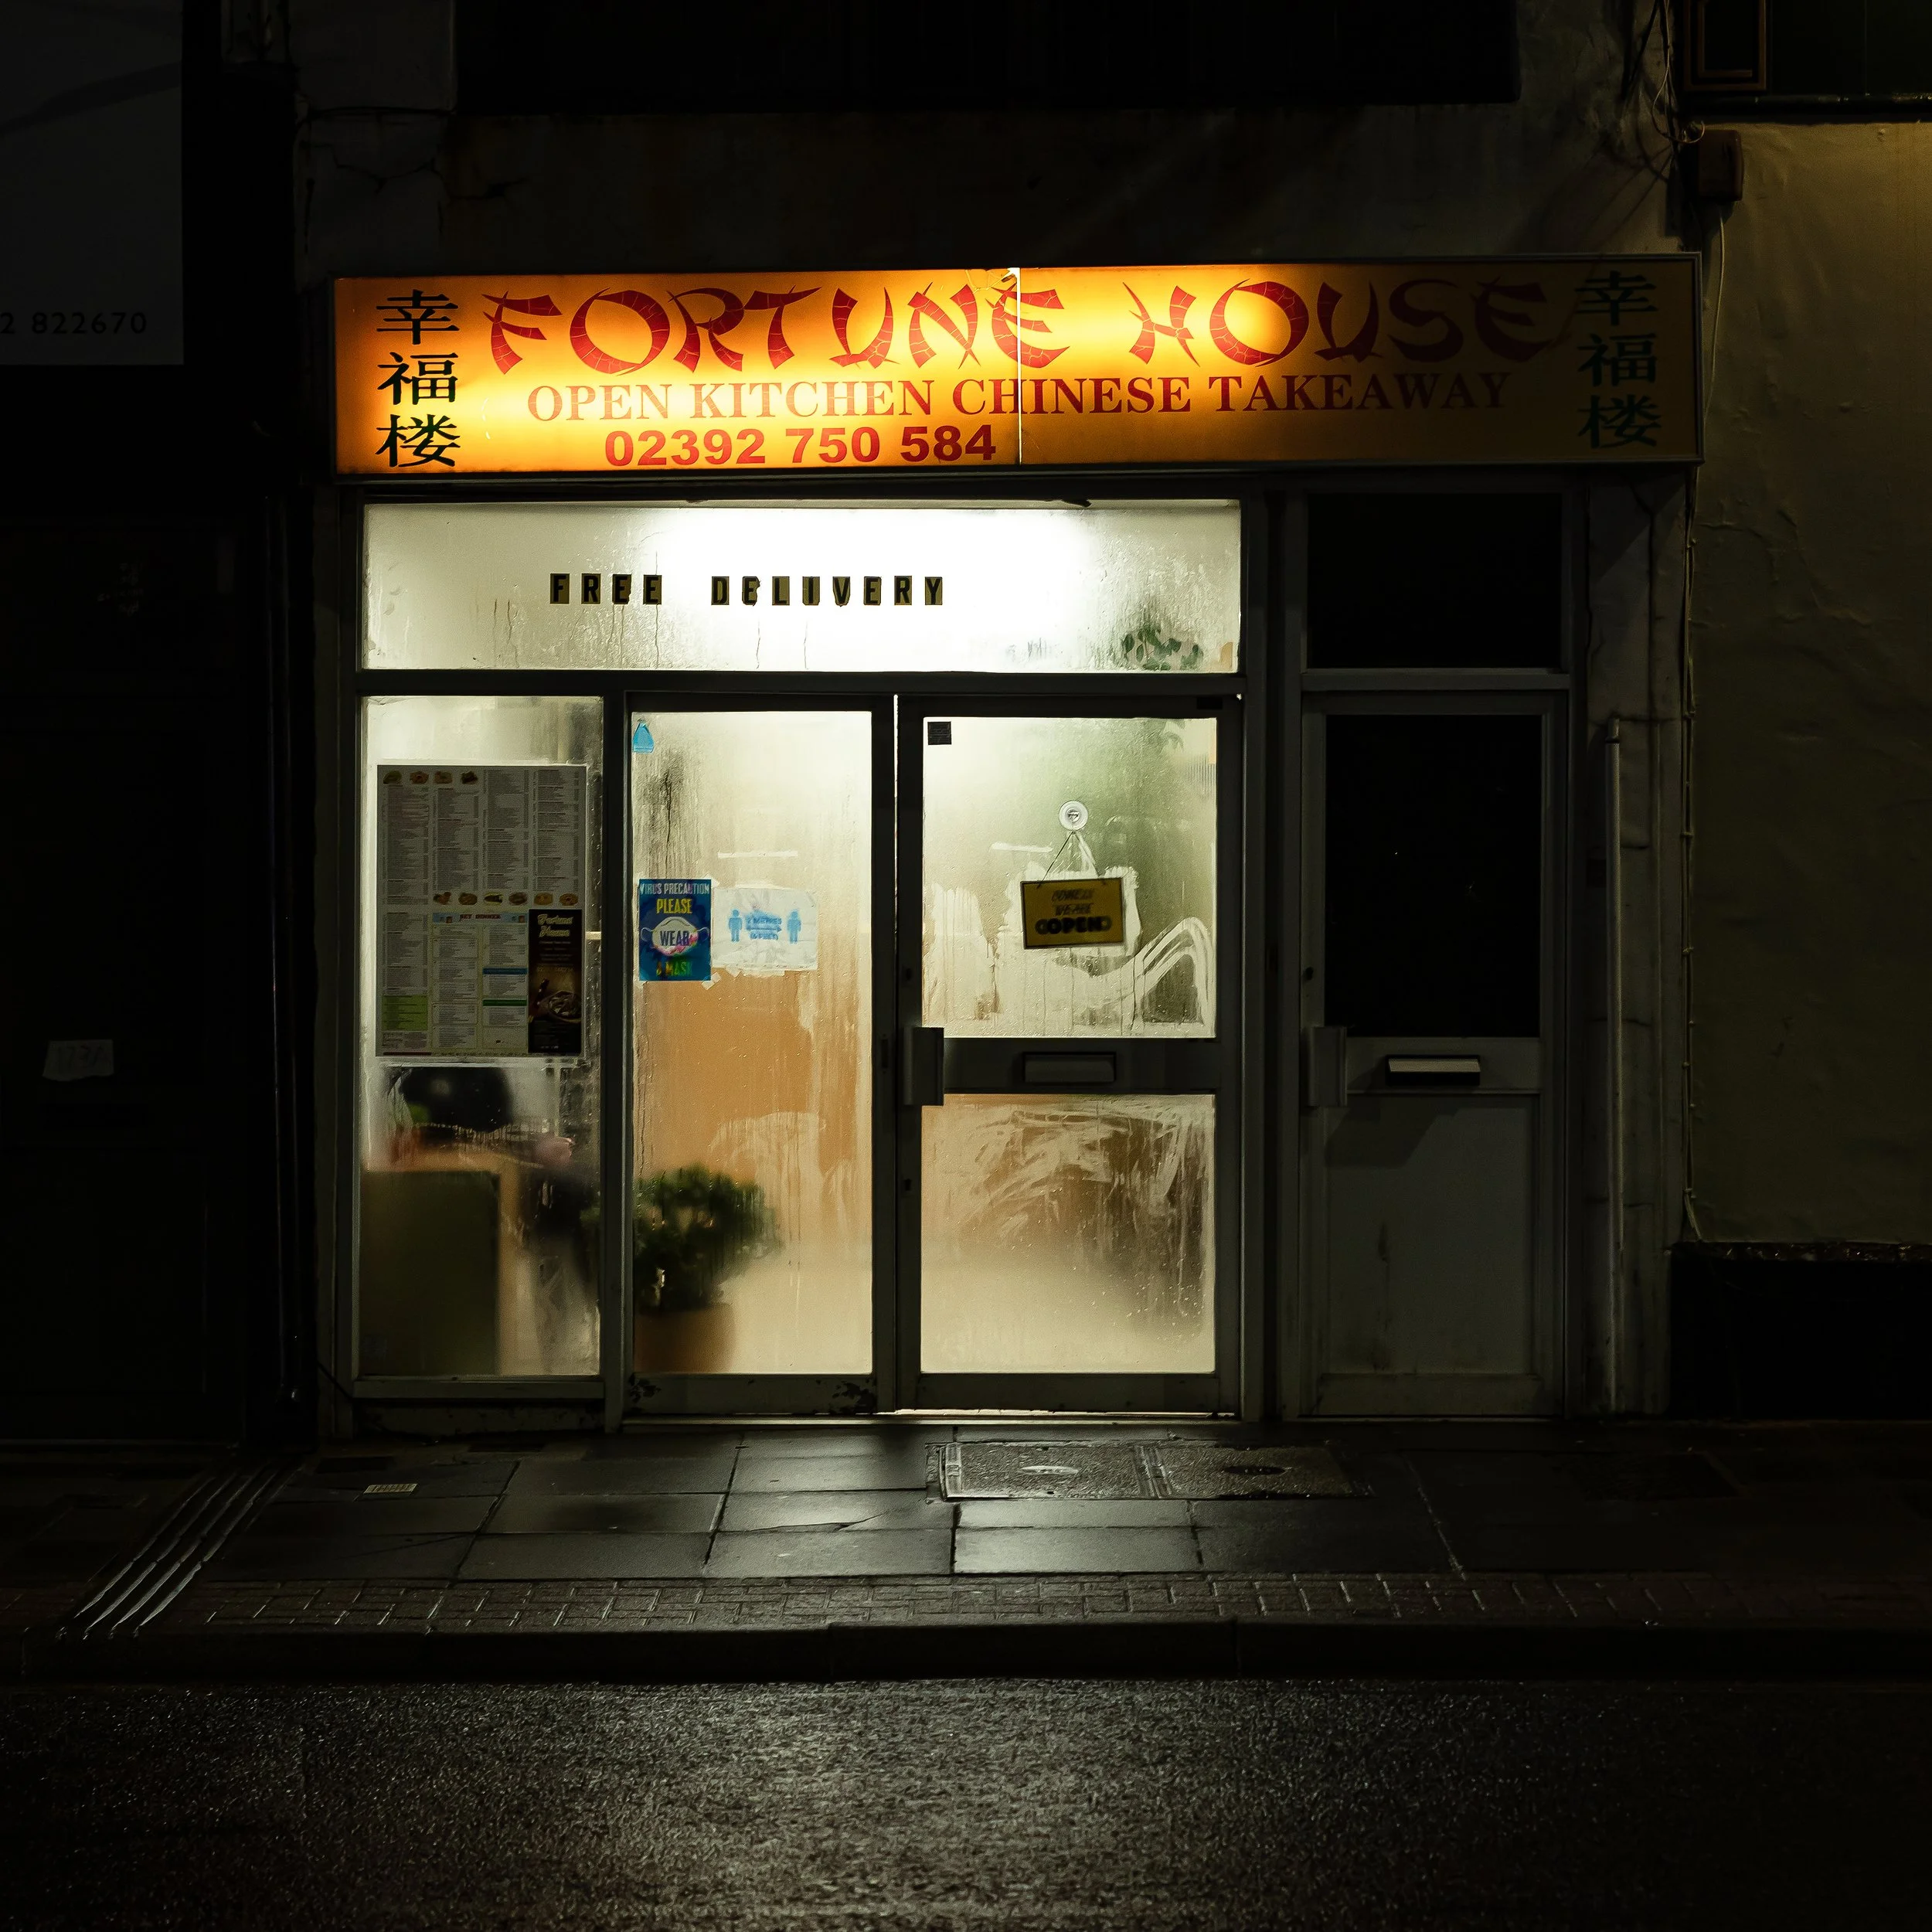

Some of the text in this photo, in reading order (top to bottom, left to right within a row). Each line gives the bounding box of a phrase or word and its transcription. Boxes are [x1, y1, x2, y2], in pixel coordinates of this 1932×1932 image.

[31, 311, 147, 334] 822670
[481, 277, 1569, 376] FORTUNE HOUSE
[1573, 269, 1663, 450] 幸福楼
[376, 289, 461, 468] 幸福楼
[527, 372, 1511, 422] OPEN KITCHEN CHINESE TAKEAWAY
[604, 424, 996, 466] 02392 750 584
[551, 574, 943, 606] FREE DELIVERY
[640, 883, 710, 895] VIRUS PRECAUTION
[656, 898, 692, 913] PLEASE
[659, 930, 689, 946] WEAR
